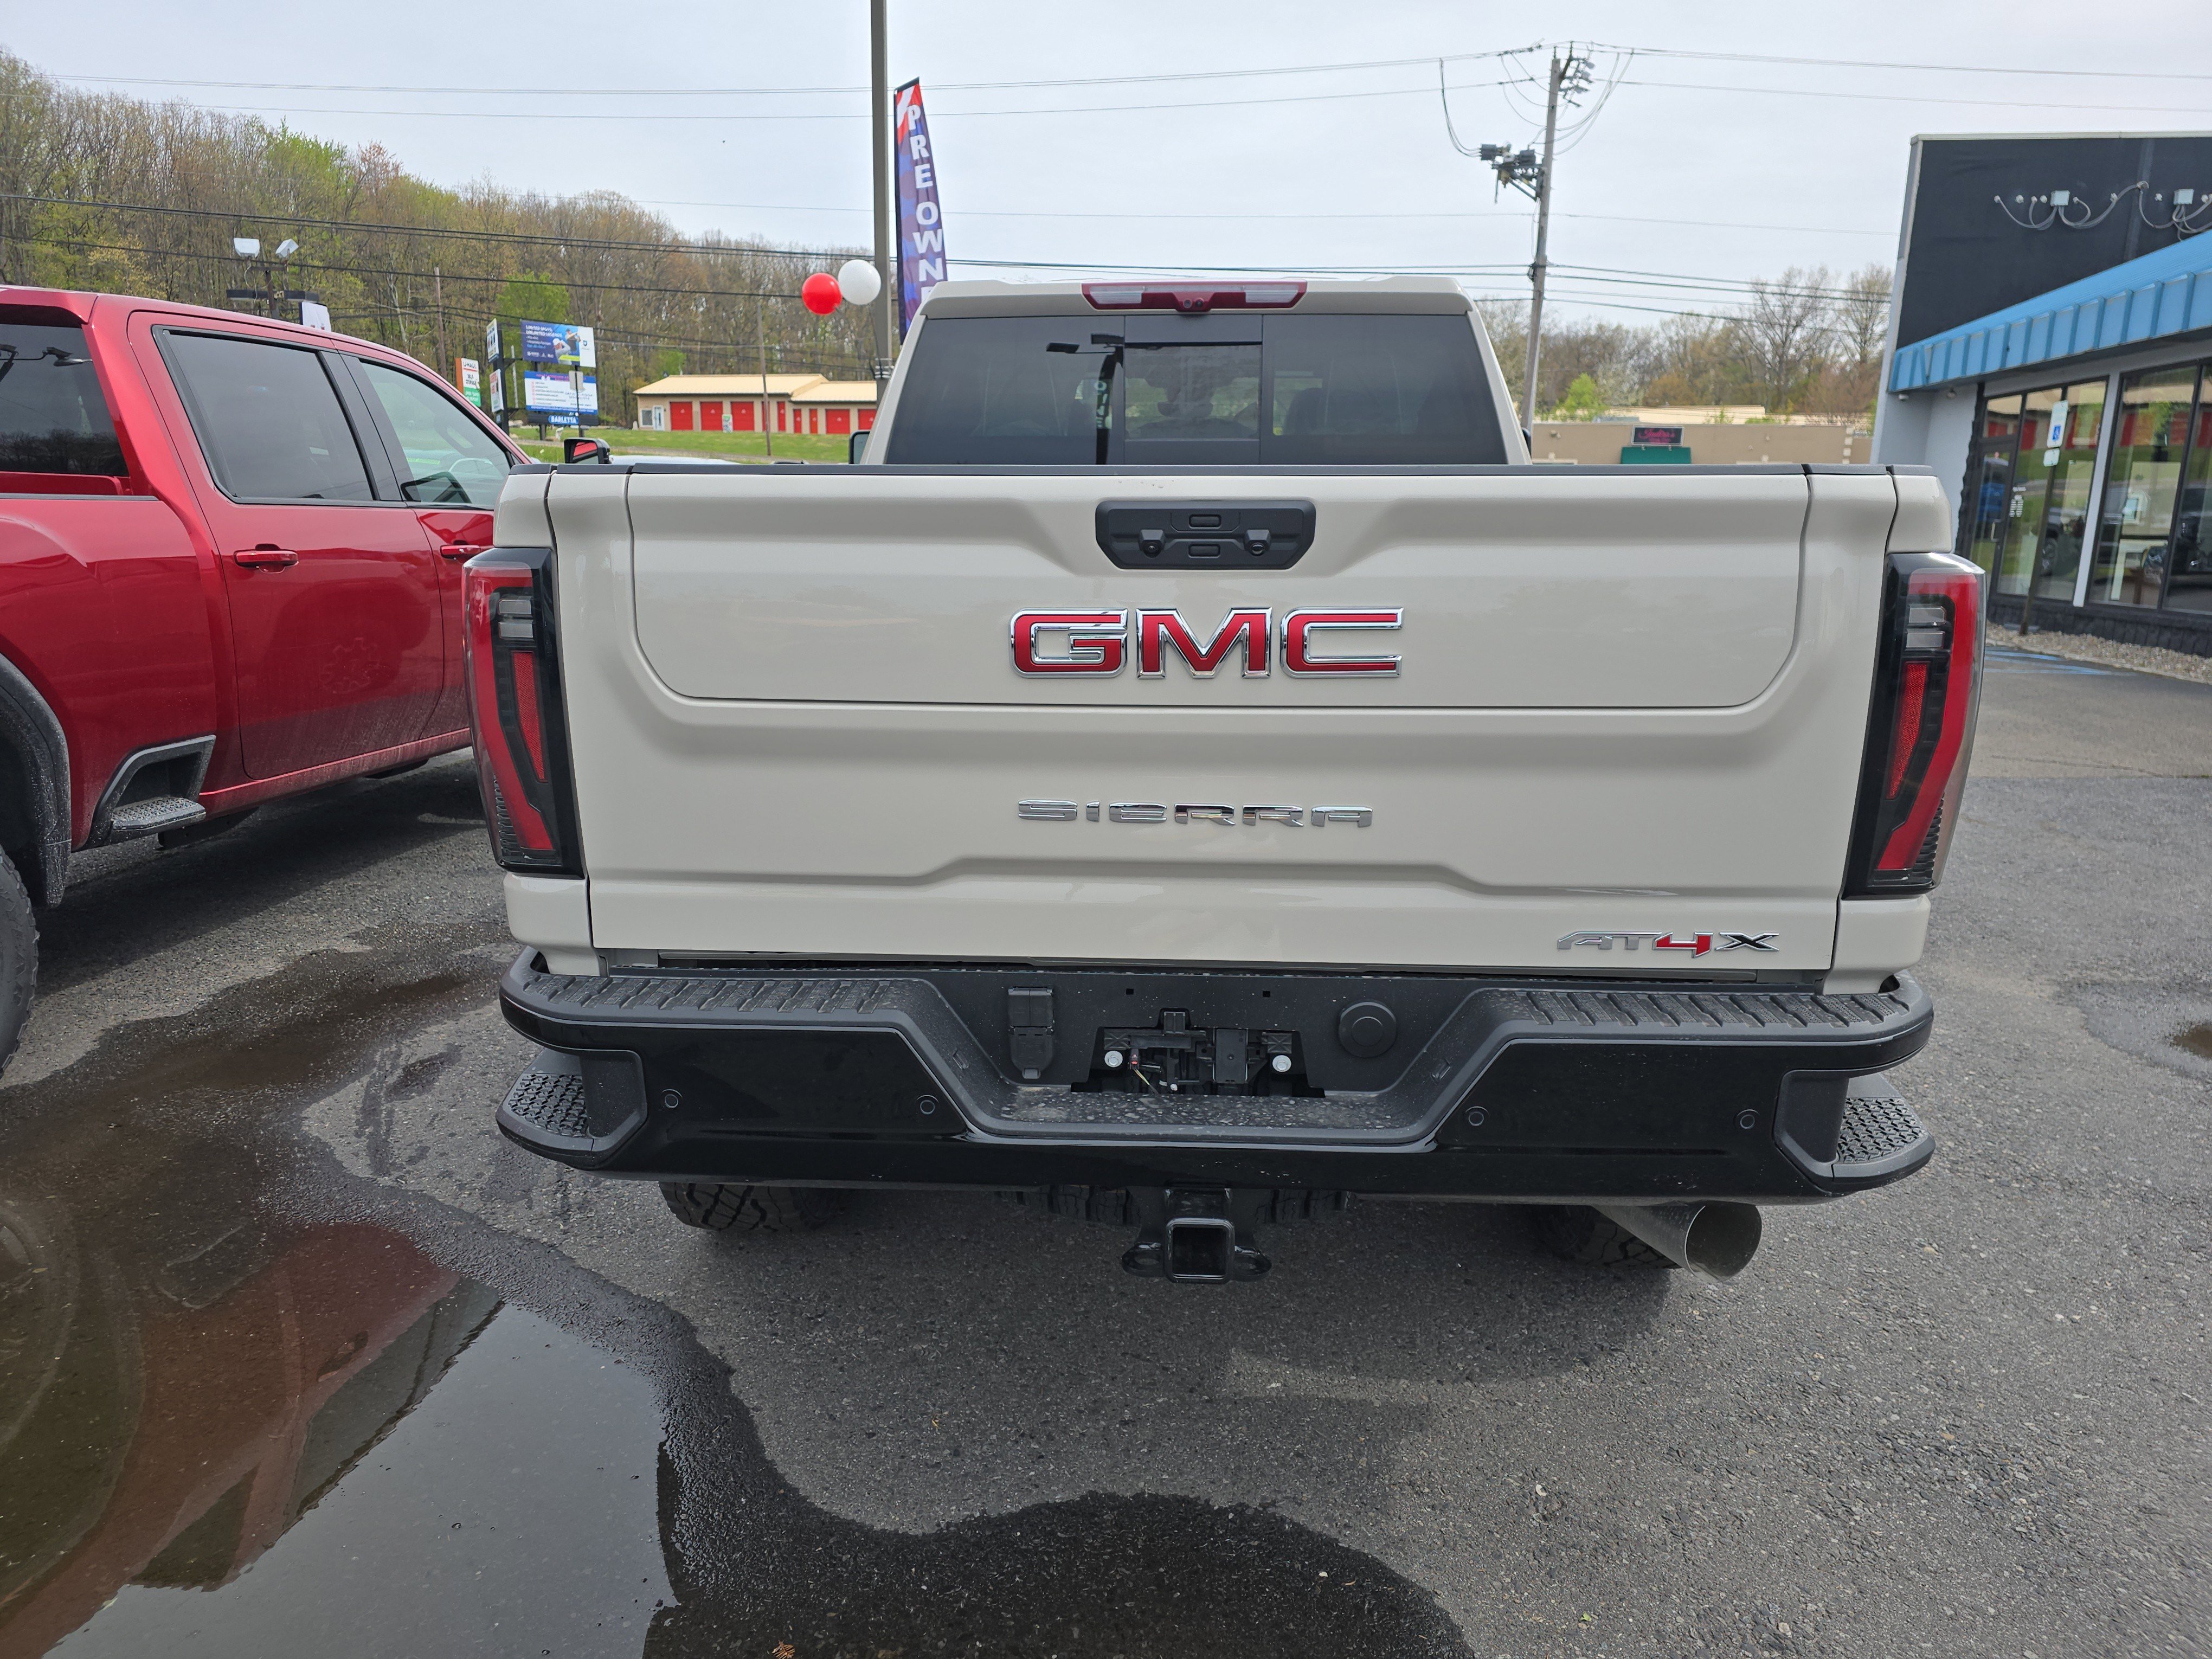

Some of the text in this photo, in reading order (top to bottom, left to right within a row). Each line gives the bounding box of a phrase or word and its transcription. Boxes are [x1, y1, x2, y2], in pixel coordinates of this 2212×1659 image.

[906, 104, 933, 189] PRE
[1010, 607, 1404, 679] GMC
[1018, 799, 1373, 828] SIERRA
[1557, 931, 1779, 959] AT4X
